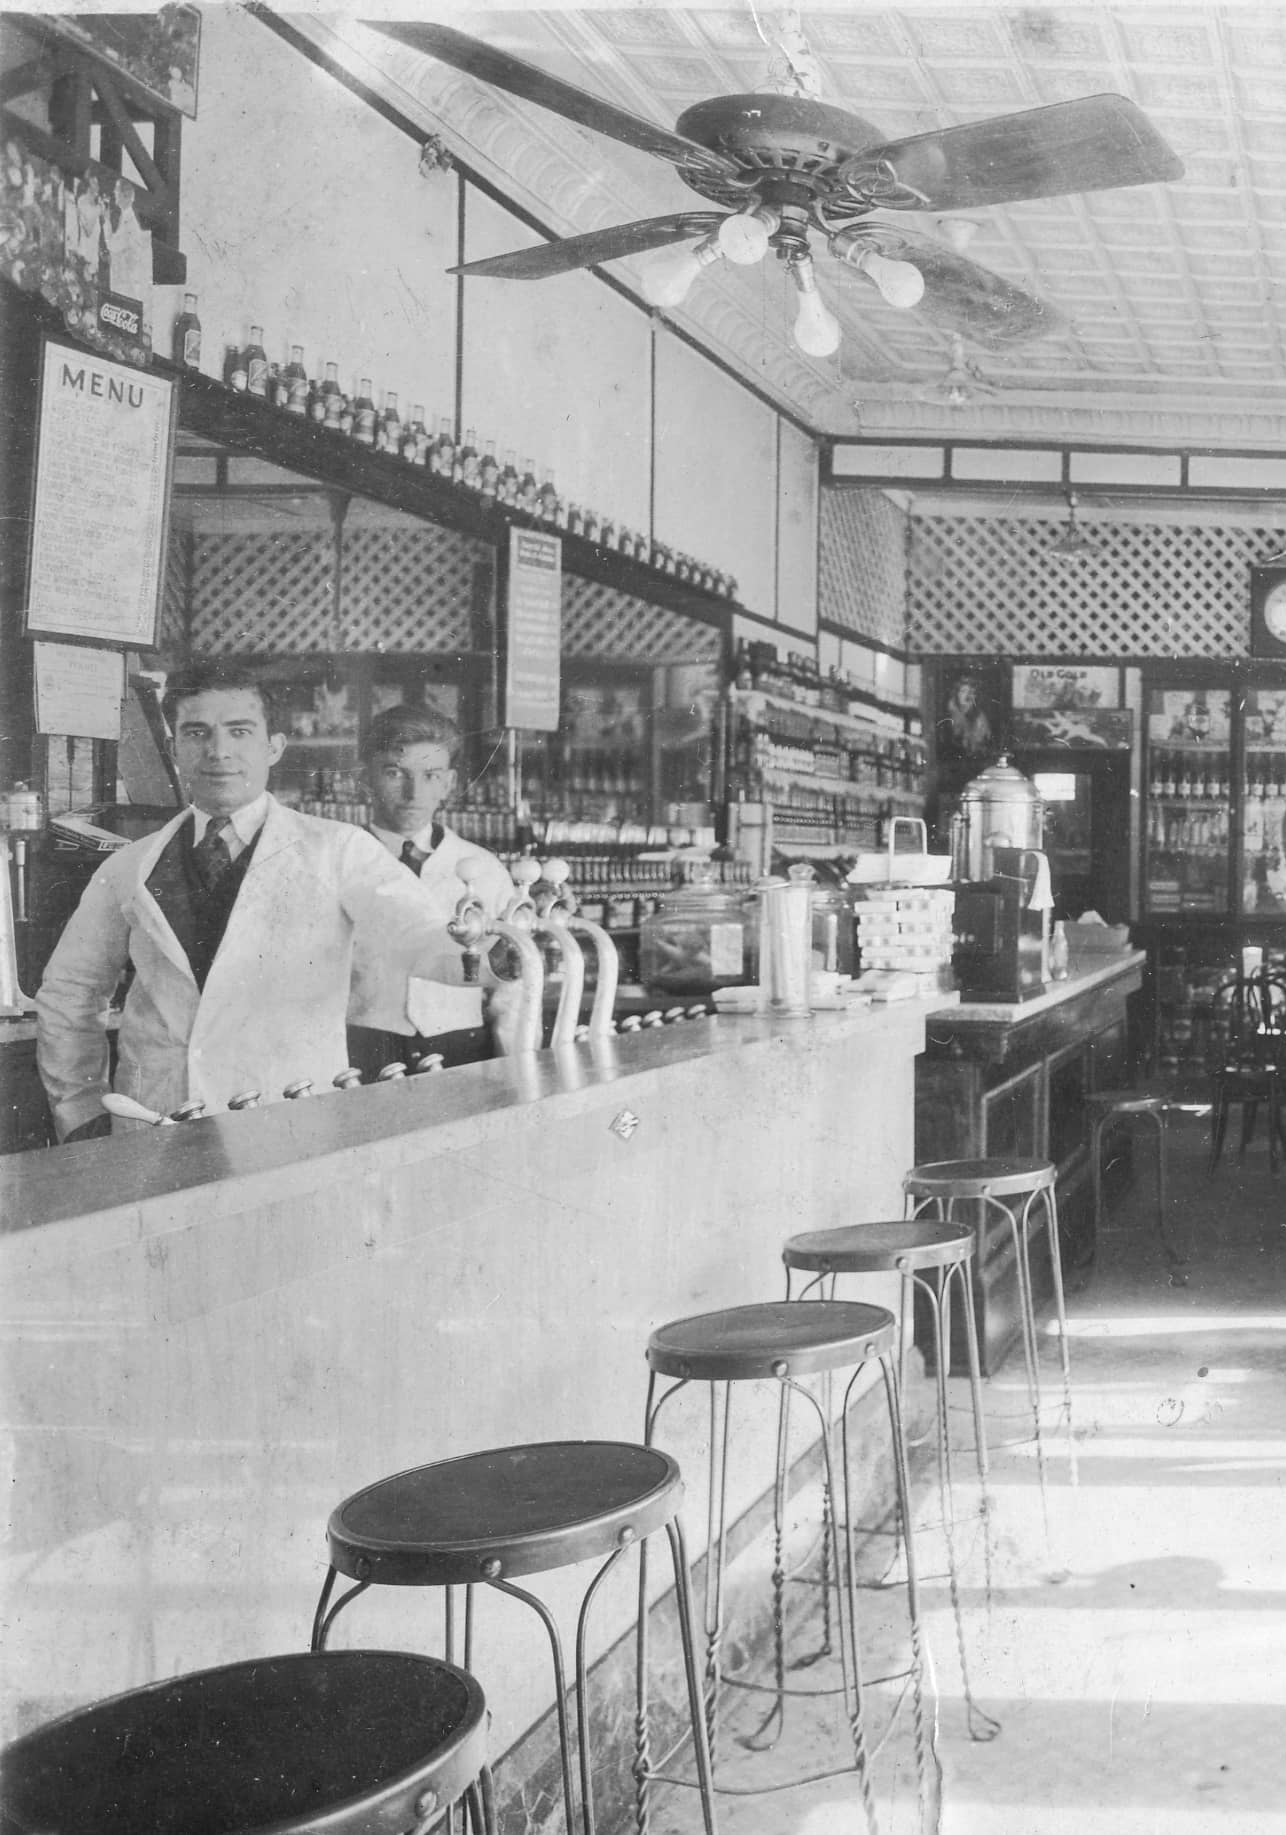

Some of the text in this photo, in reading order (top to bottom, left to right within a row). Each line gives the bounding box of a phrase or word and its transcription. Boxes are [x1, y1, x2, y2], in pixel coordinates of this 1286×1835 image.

[61, 363, 144, 409] MENU
[1029, 668, 1088, 681] OLD GOLD
